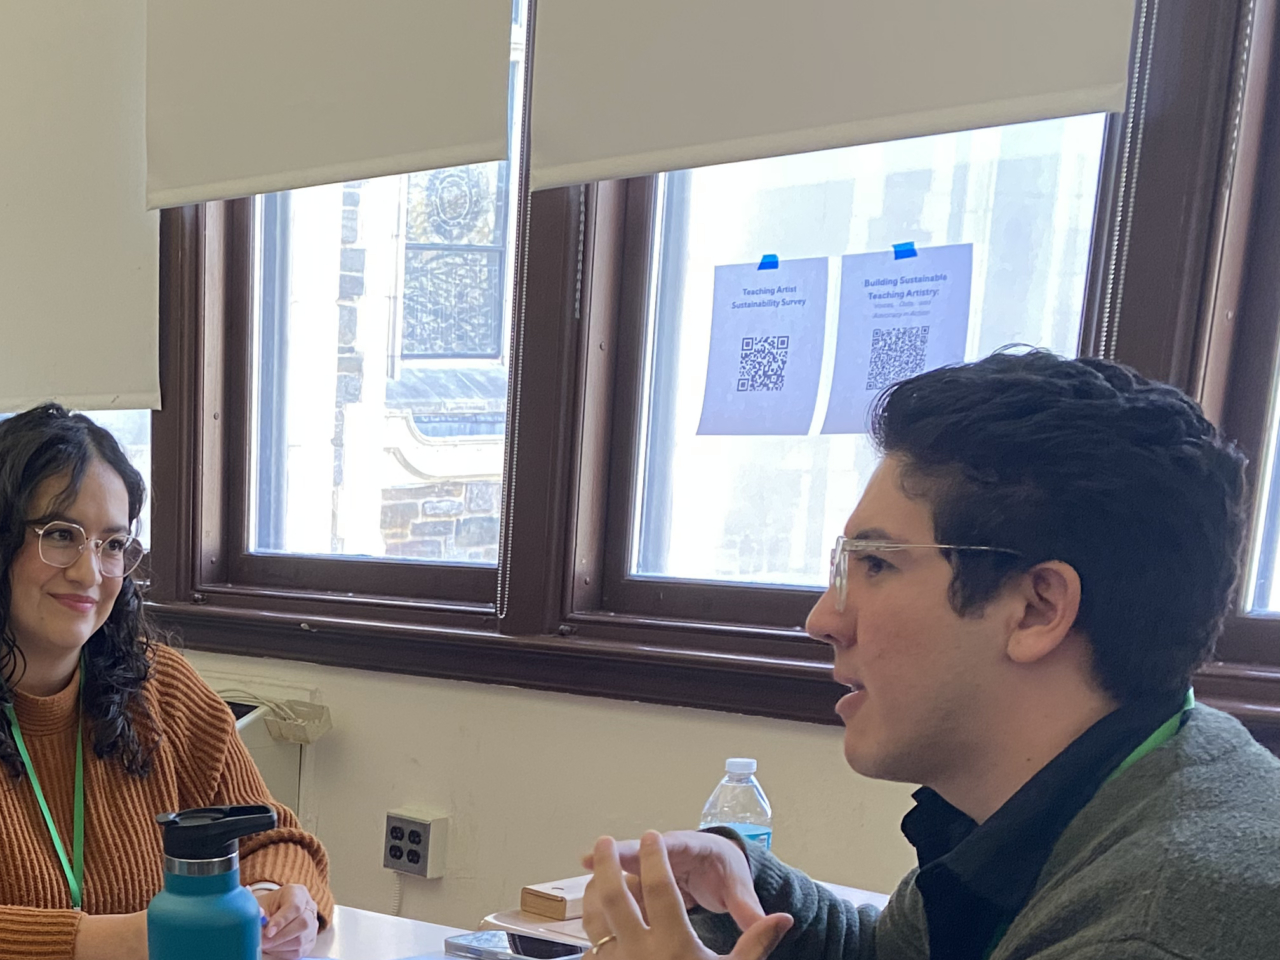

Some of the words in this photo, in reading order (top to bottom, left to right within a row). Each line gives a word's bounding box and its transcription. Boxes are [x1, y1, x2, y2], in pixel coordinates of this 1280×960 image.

[864, 278, 899, 287] Building
[900, 274, 948, 284] Sustainable
[742, 287, 775, 296] Teaching
[776, 285, 797, 294] Artist
[868, 291, 905, 300] Teaching
[731, 299, 780, 309] Sustainability
[781, 298, 806, 307] Survey
